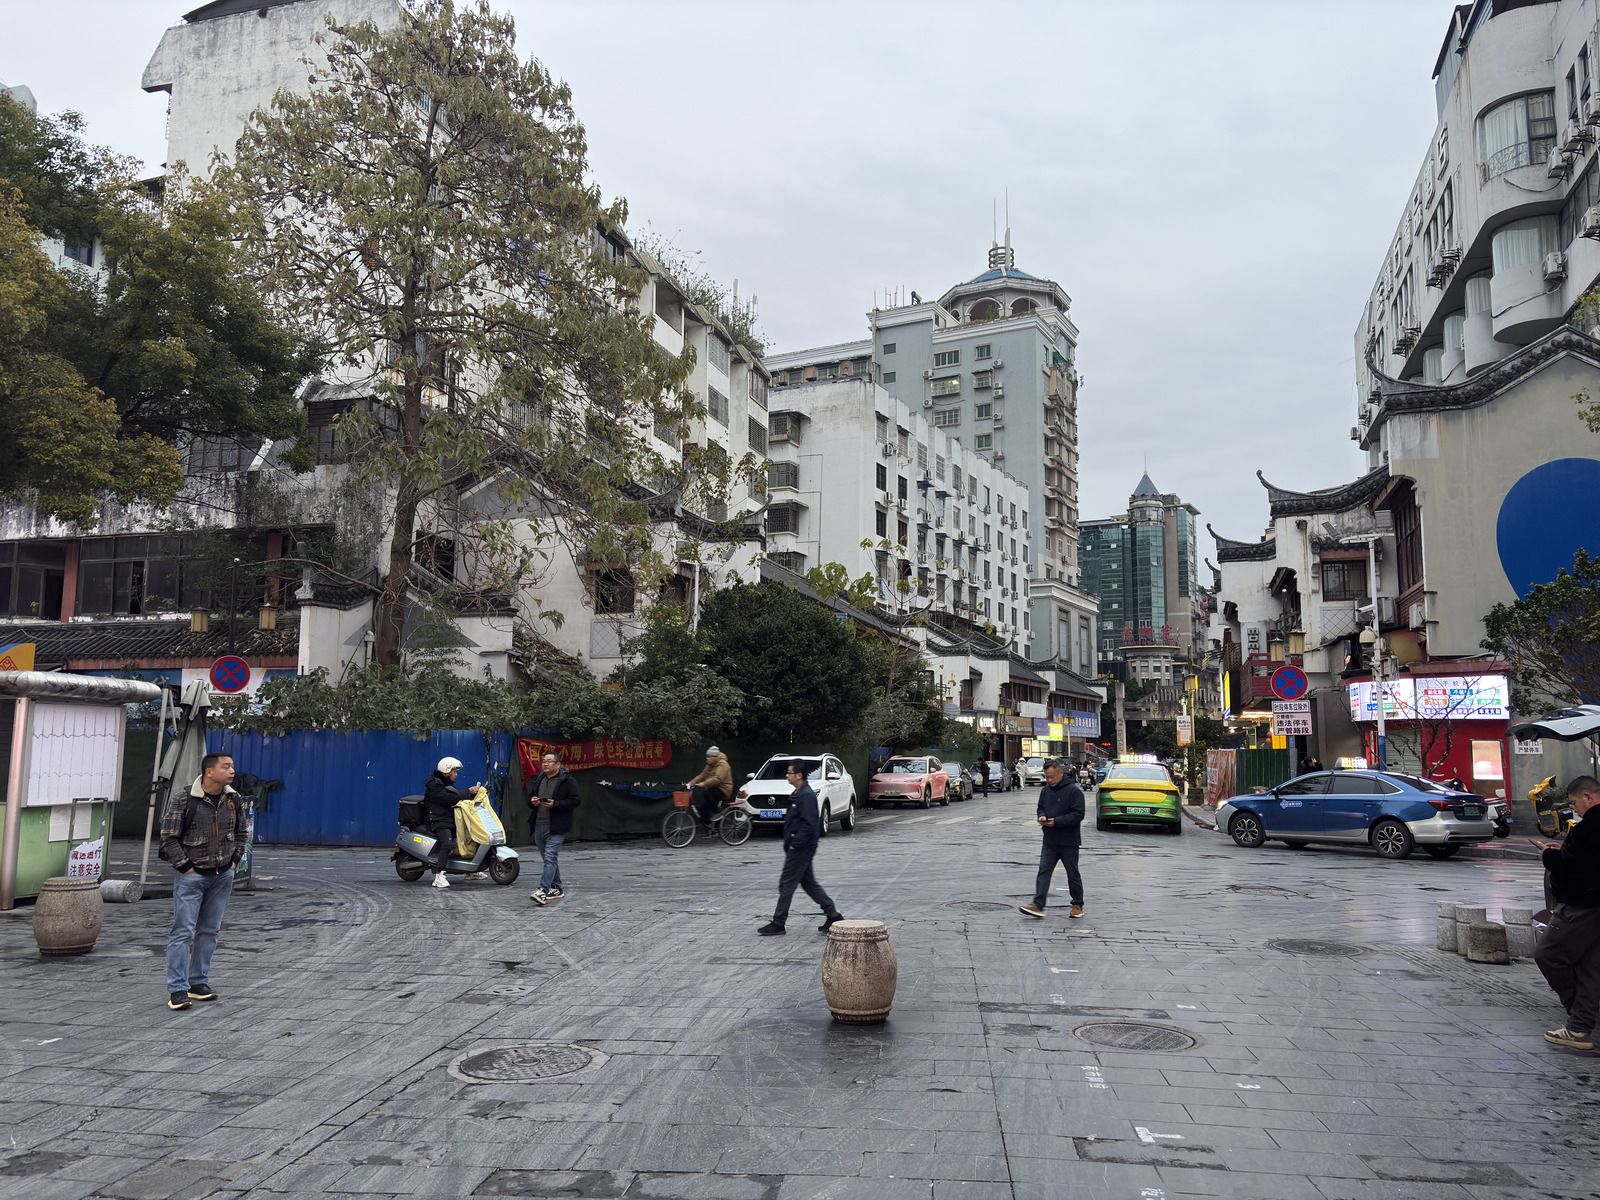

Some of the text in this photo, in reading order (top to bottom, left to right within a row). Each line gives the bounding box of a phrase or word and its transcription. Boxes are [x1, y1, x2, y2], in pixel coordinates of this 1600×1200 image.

[1277, 727, 1310, 735] 严管路段
[70, 862, 101, 877] 注意安全
